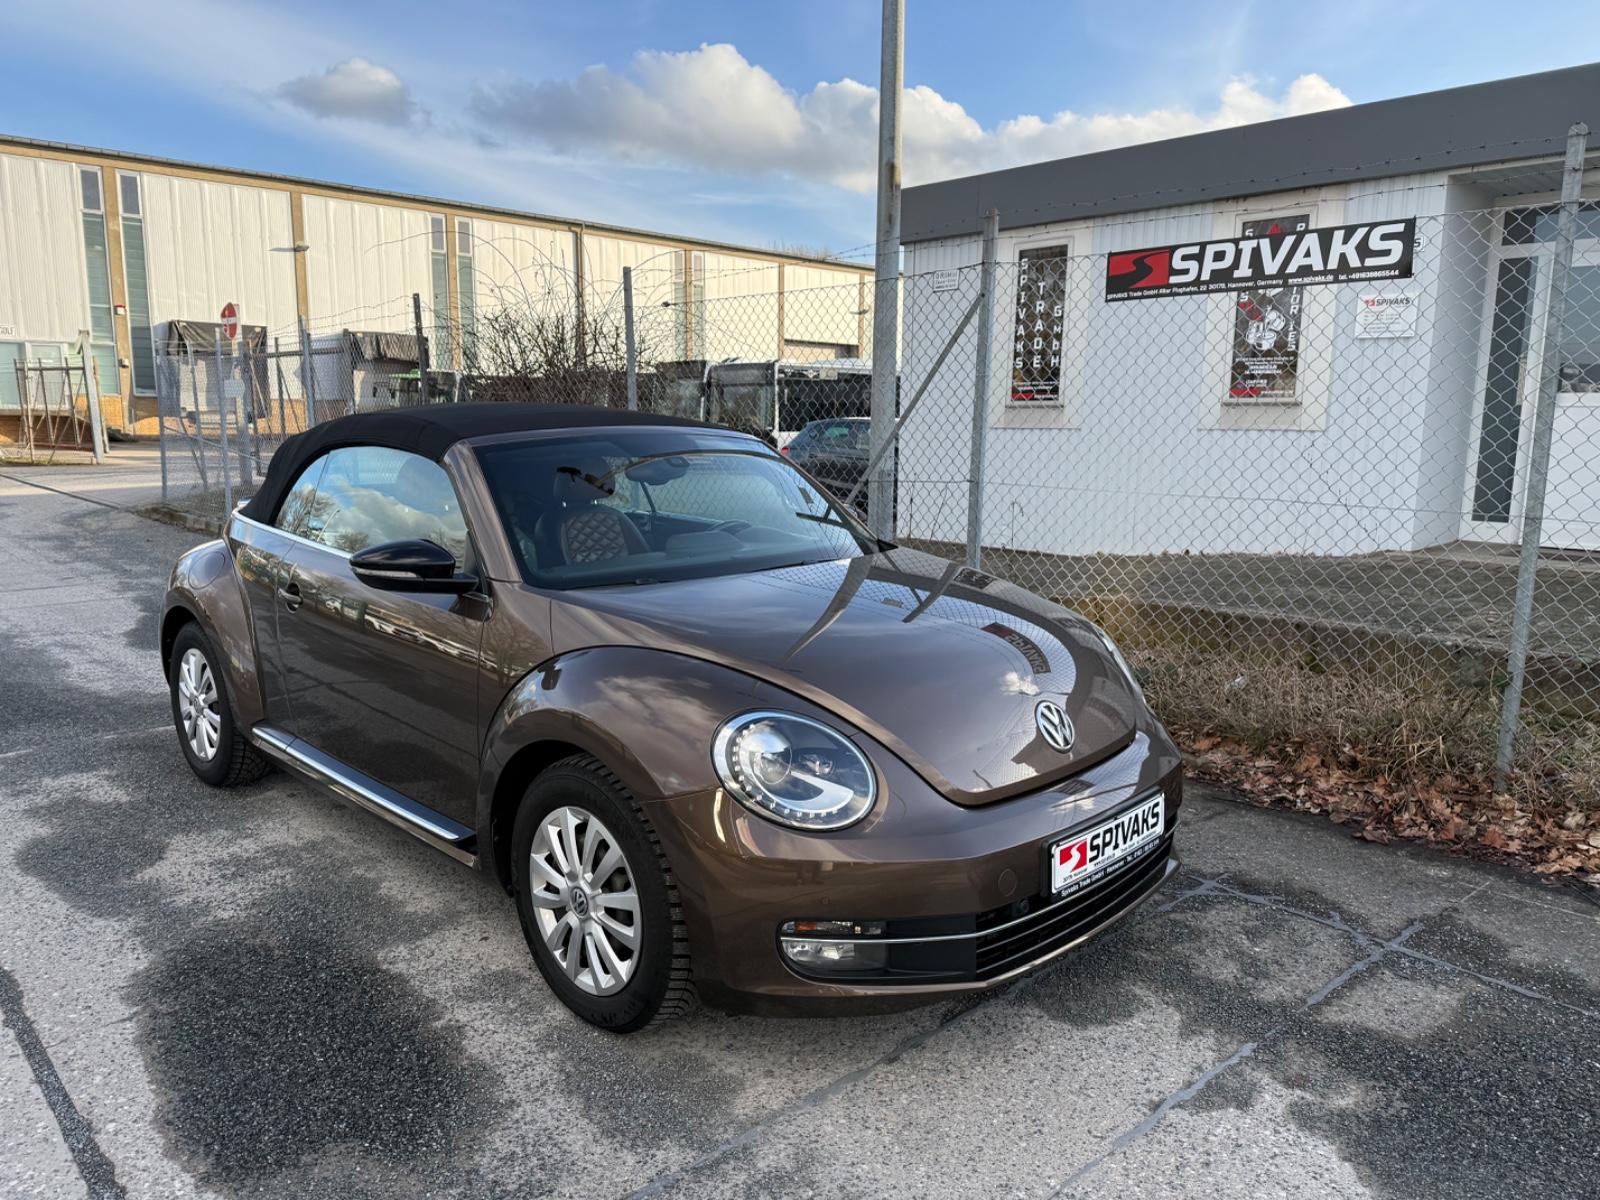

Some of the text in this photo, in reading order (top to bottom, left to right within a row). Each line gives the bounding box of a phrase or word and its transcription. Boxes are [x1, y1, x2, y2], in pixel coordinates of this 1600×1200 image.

[1168, 223, 1405, 283] SPIVAKS
[1256, 278, 1284, 287] Germany
[1032, 282, 1046, 368] TRADE
[1376, 297, 1411, 307] SPIVAKS
[1088, 801, 1161, 863] SPIVAKS
